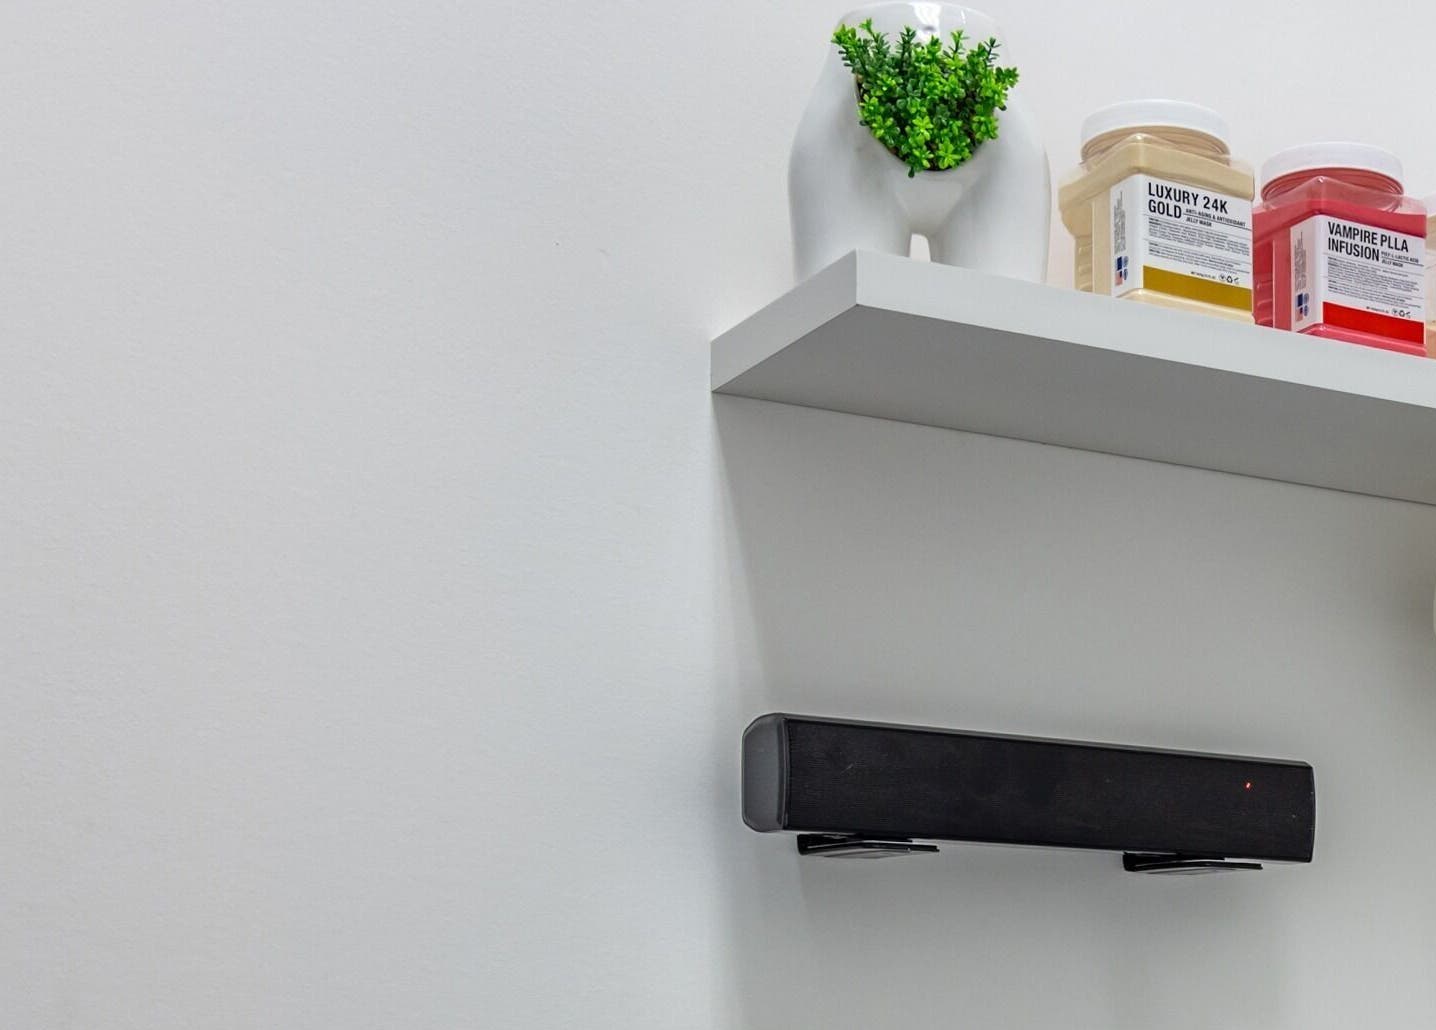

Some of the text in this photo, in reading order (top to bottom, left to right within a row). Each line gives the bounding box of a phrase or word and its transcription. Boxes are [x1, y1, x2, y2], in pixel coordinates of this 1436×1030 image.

[1148, 182, 1229, 215] LUXURY 24K
[1148, 199, 1183, 219] GOLD
[1327, 221, 1409, 253] VAMPIRE PLLA
[1327, 237, 1380, 262] INFUSION
